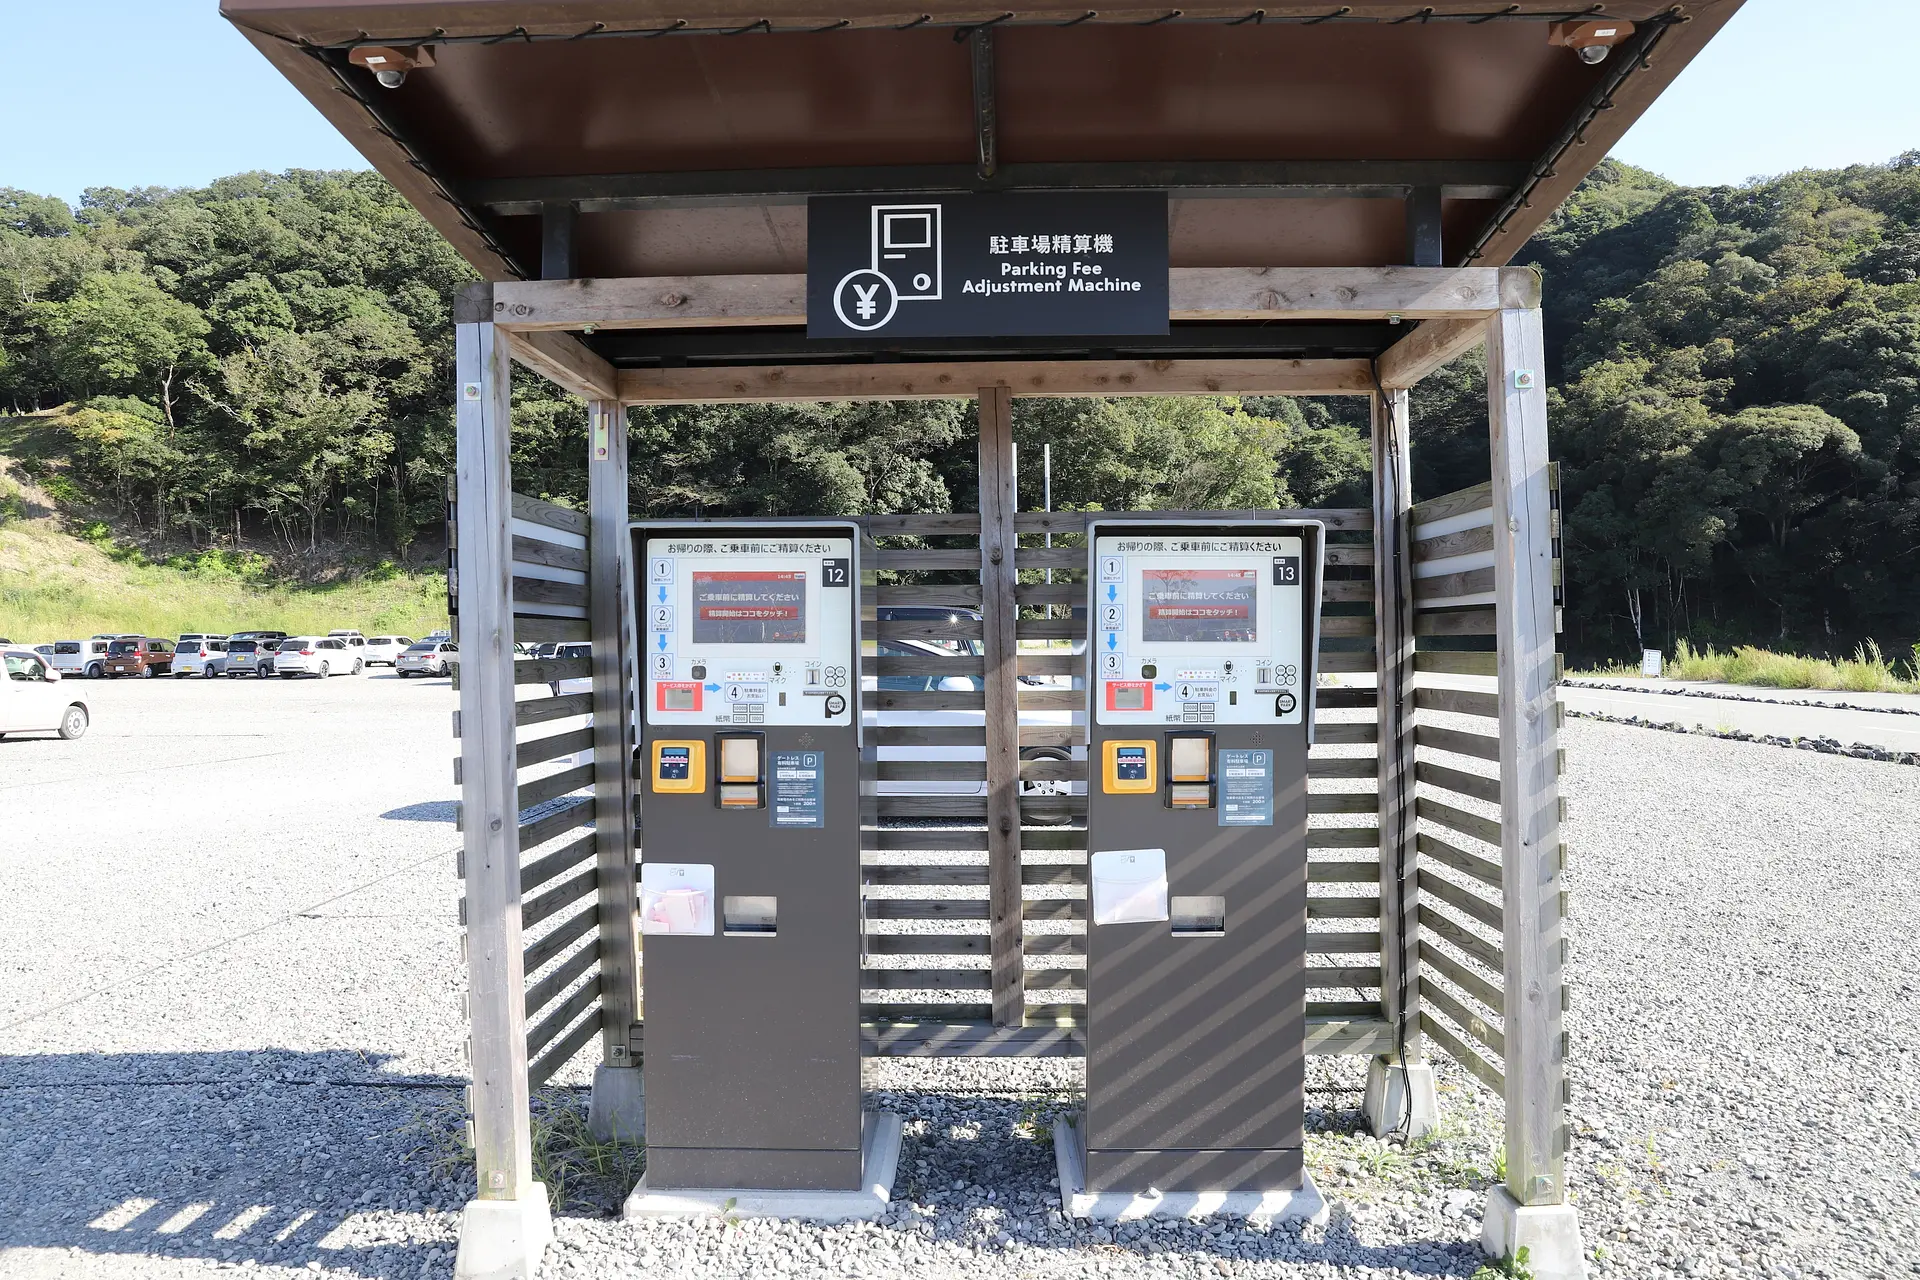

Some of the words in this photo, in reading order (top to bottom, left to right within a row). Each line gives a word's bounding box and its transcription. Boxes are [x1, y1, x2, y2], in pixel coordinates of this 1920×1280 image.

[989, 234, 1114, 255] 駐車場精算機
[1001, 261, 1067, 279] Parking
[1072, 261, 1103, 276] Fee
[961, 279, 1063, 297] Adjustment
[1067, 277, 1142, 292] Machine
[668, 543, 832, 554] お帰りの際、ご乗車前にご精算ください
[1117, 542, 1282, 552] お帰りの際、ご乗車前にご精算ください
[828, 568, 844, 582] 12
[1278, 566, 1294, 580] 13
[699, 592, 799, 602] ご乗車前に精算してください
[1149, 592, 1249, 600] ご乗車前に精算してください
